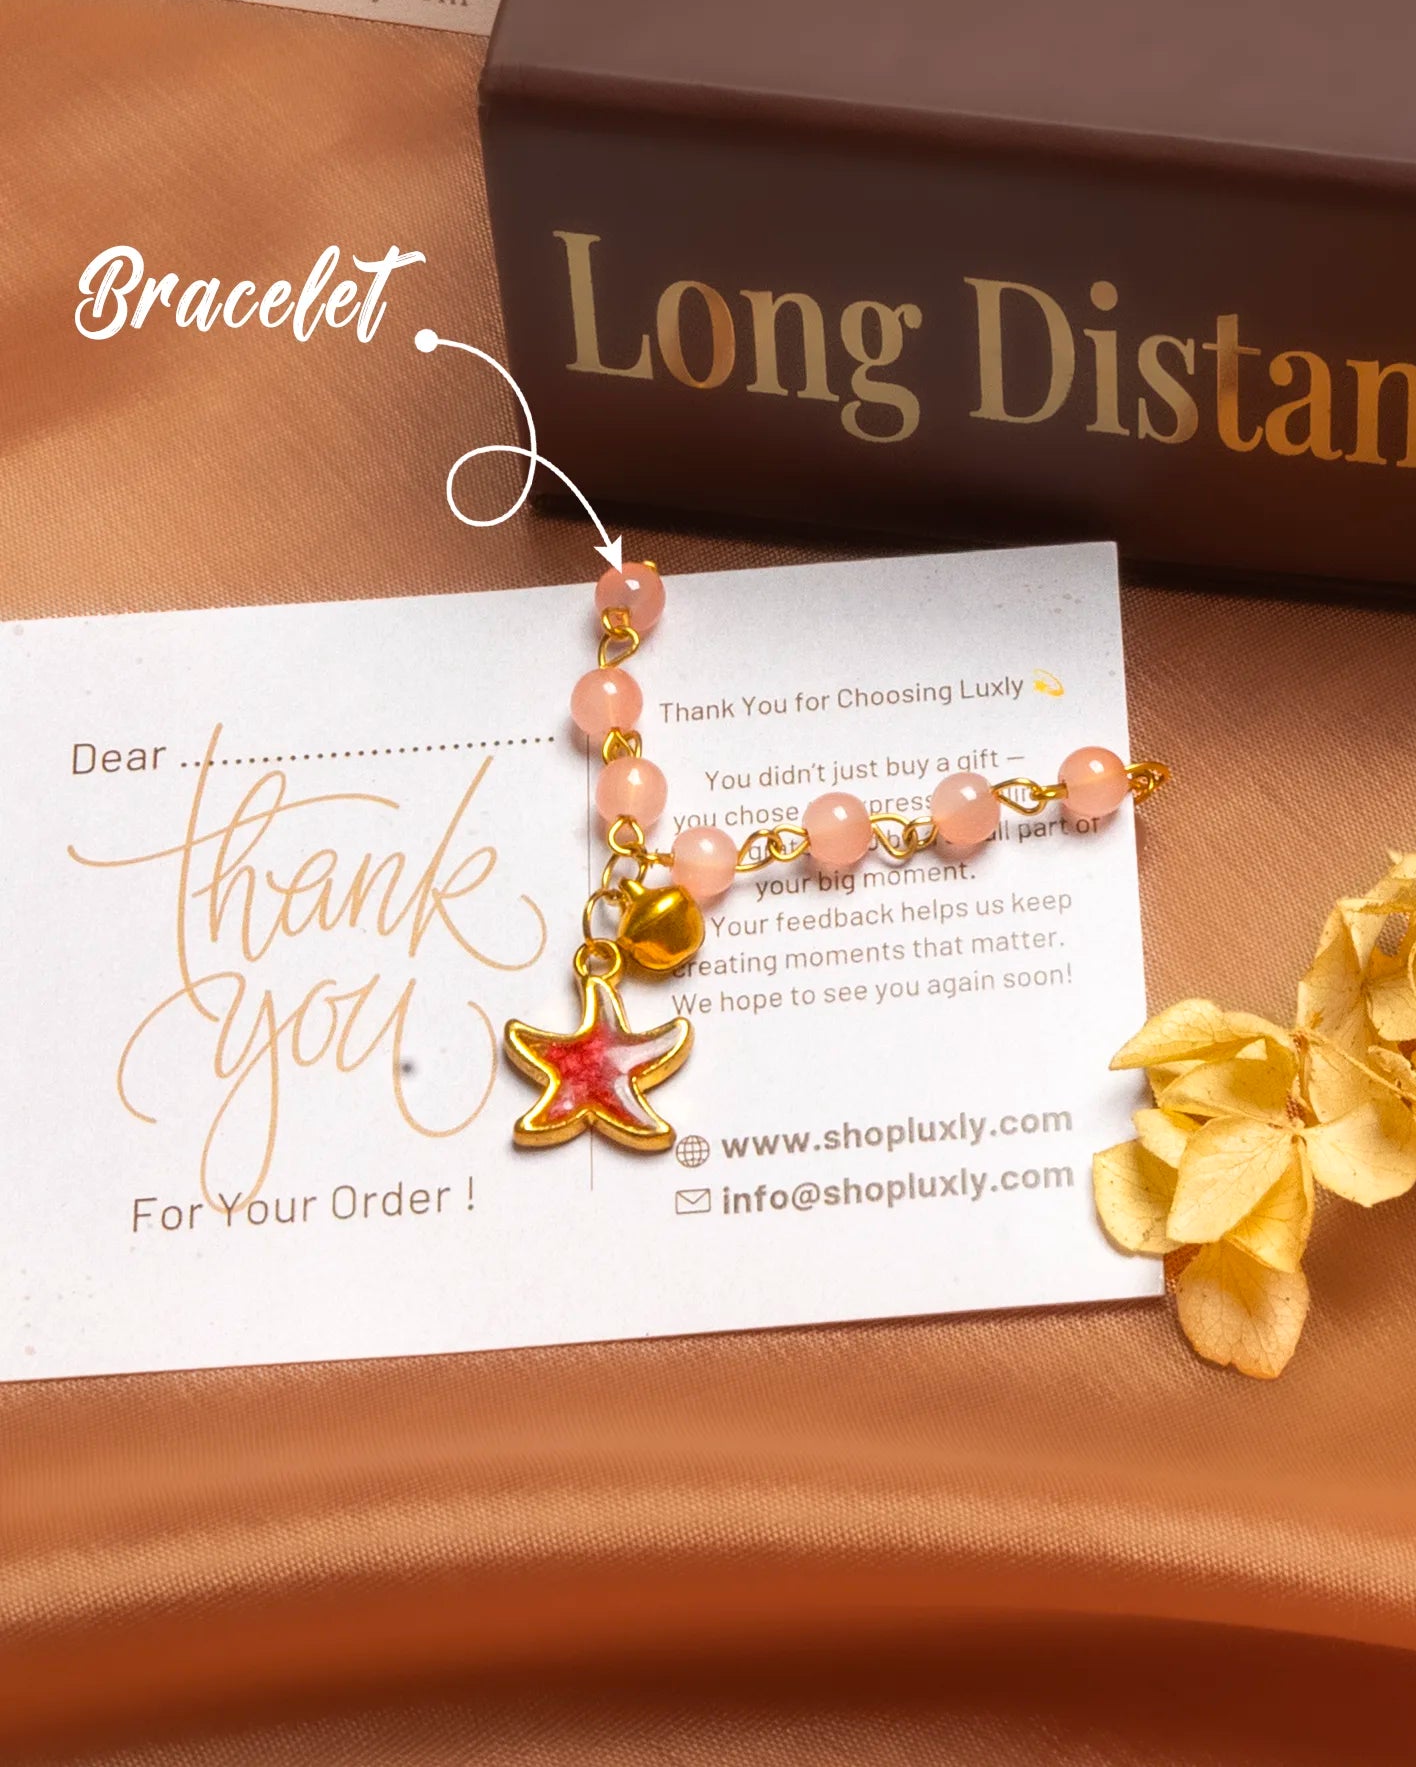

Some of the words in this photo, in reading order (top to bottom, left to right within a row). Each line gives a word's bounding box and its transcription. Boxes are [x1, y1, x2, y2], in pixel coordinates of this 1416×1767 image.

[551, 228, 922, 444] Long
[659, 699, 736, 724] Thank
[741, 695, 788, 717] You
[794, 692, 830, 714] for
[837, 682, 953, 710] Choosing
[960, 676, 1025, 702] Luxly
[705, 770, 751, 792] You
[831, 759, 878, 786] just
[886, 755, 930, 780] buy
[936, 756, 950, 772] a
[957, 749, 998, 772] gift
[673, 812, 717, 836] you
[725, 804, 799, 827] chose
[1018, 816, 1069, 844] part
[1075, 817, 1101, 834] of
[67, 722, 548, 1023] thank
[755, 875, 812, 903] your
[818, 870, 856, 896] big
[863, 862, 976, 888] moment.
[711, 915, 769, 938] Your
[776, 903, 894, 933] feedback
[901, 898, 969, 924] helps
[976, 898, 1004, 916] us
[1011, 892, 1072, 914] keep
[672, 952, 777, 978] creating
[785, 941, 906, 969] moments
[913, 937, 964, 959] that
[971, 930, 1065, 954] matter.
[672, 992, 713, 1016] We
[720, 990, 783, 1015] hope
[791, 986, 816, 1006] to
[823, 984, 868, 1003] see
[875, 981, 920, 1005] you
[927, 970, 995, 999] again
[1003, 962, 1073, 989] soon!
[117, 970, 499, 1214] you
[720, 1106, 1074, 1160] www.shopluxly.com
[133, 1196, 204, 1232] For
[219, 1190, 317, 1228] Your
[331, 1181, 452, 1220] Order
[722, 1161, 1075, 1216] info@shopluxly.com
